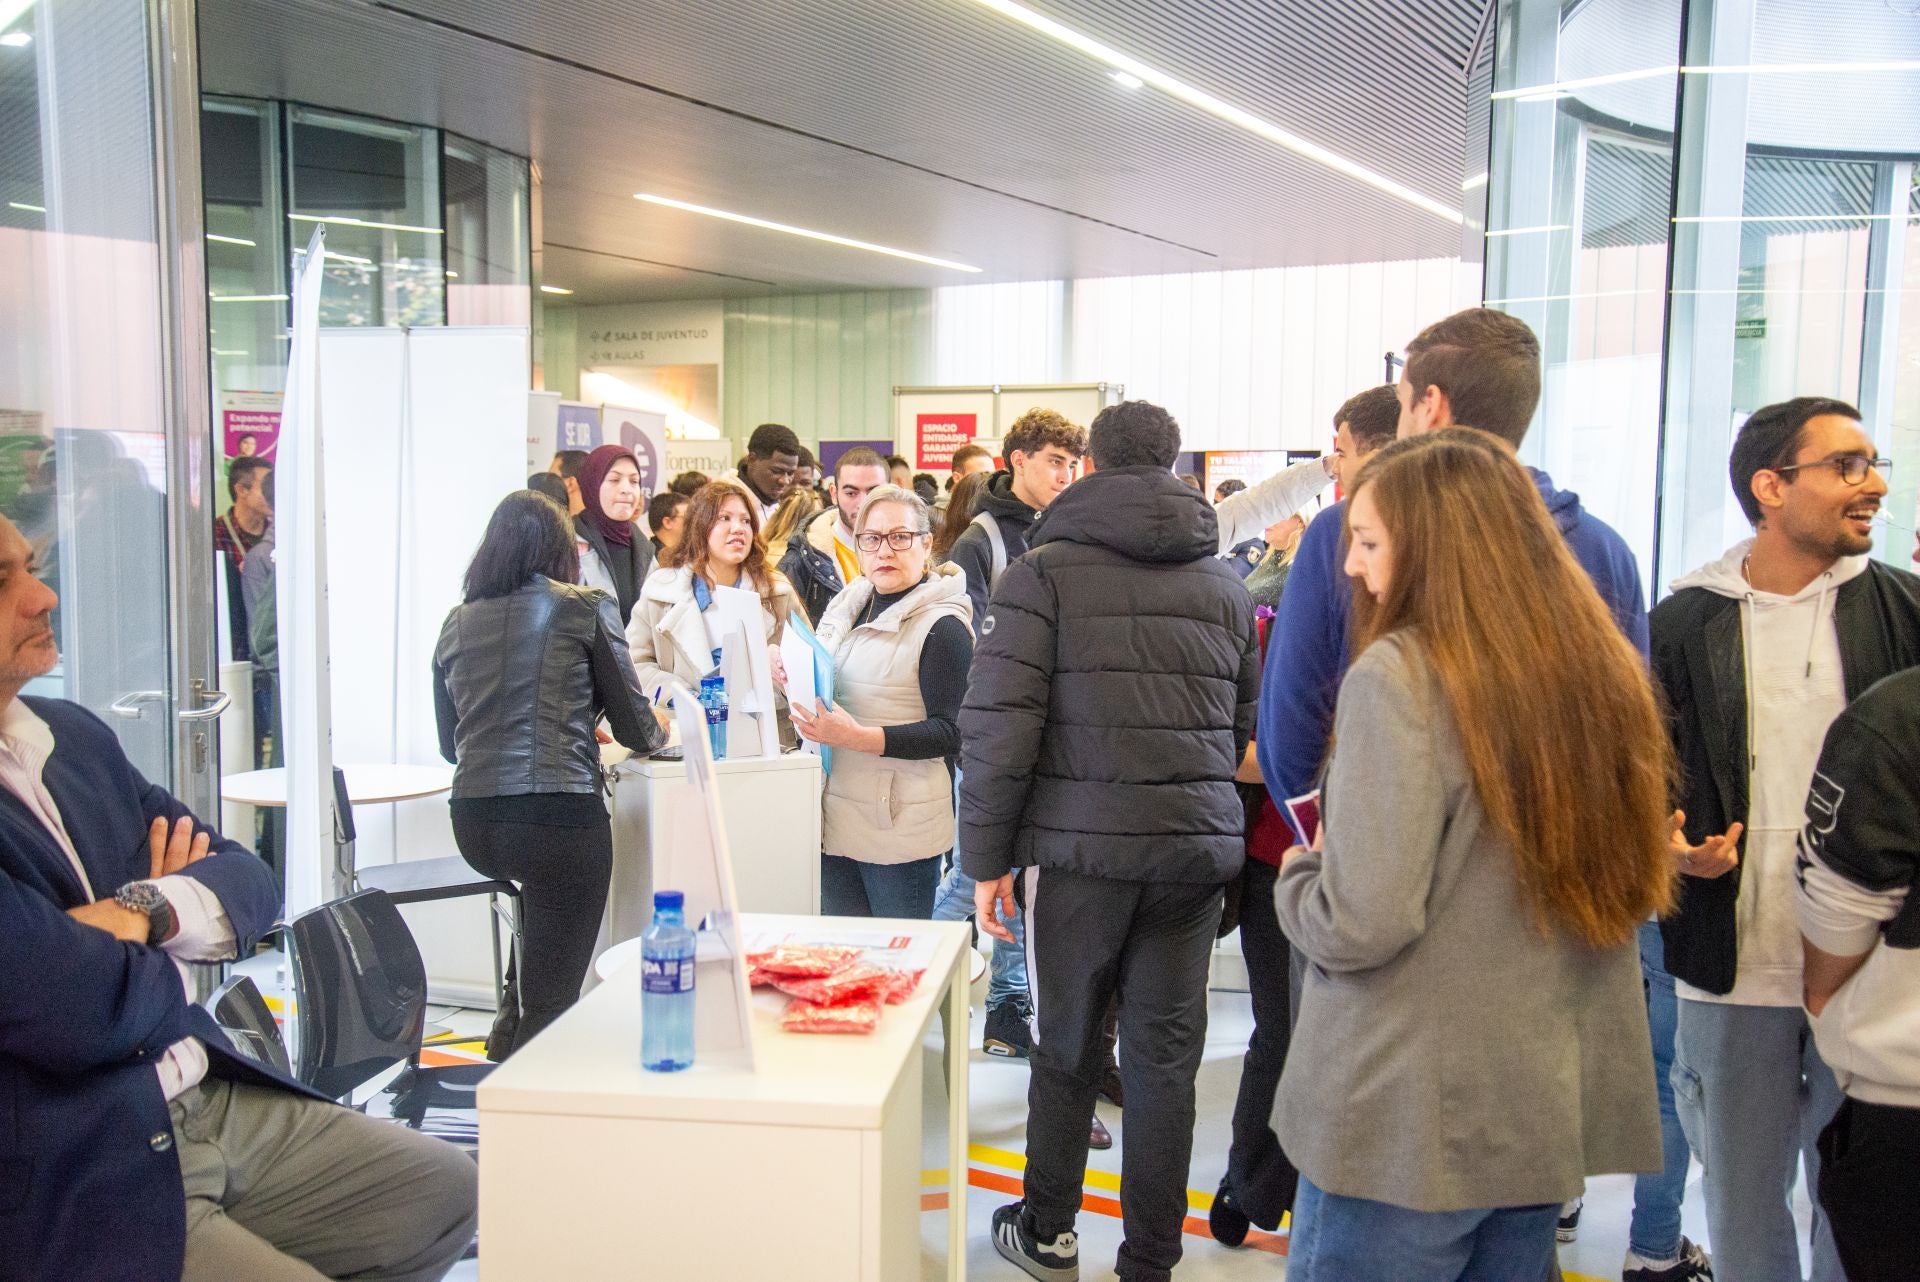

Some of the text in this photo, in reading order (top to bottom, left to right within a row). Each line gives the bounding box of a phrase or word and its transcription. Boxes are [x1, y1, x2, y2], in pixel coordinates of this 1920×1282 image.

[614, 329, 709, 341] SALA DE JUVENTUD
[615, 350, 645, 360] AULAS
[922, 423, 958, 433] ESPACIO
[922, 433, 968, 443] ENTIDADES
[922, 453, 953, 463] JUVEN
[1210, 456, 1223, 465] TU
